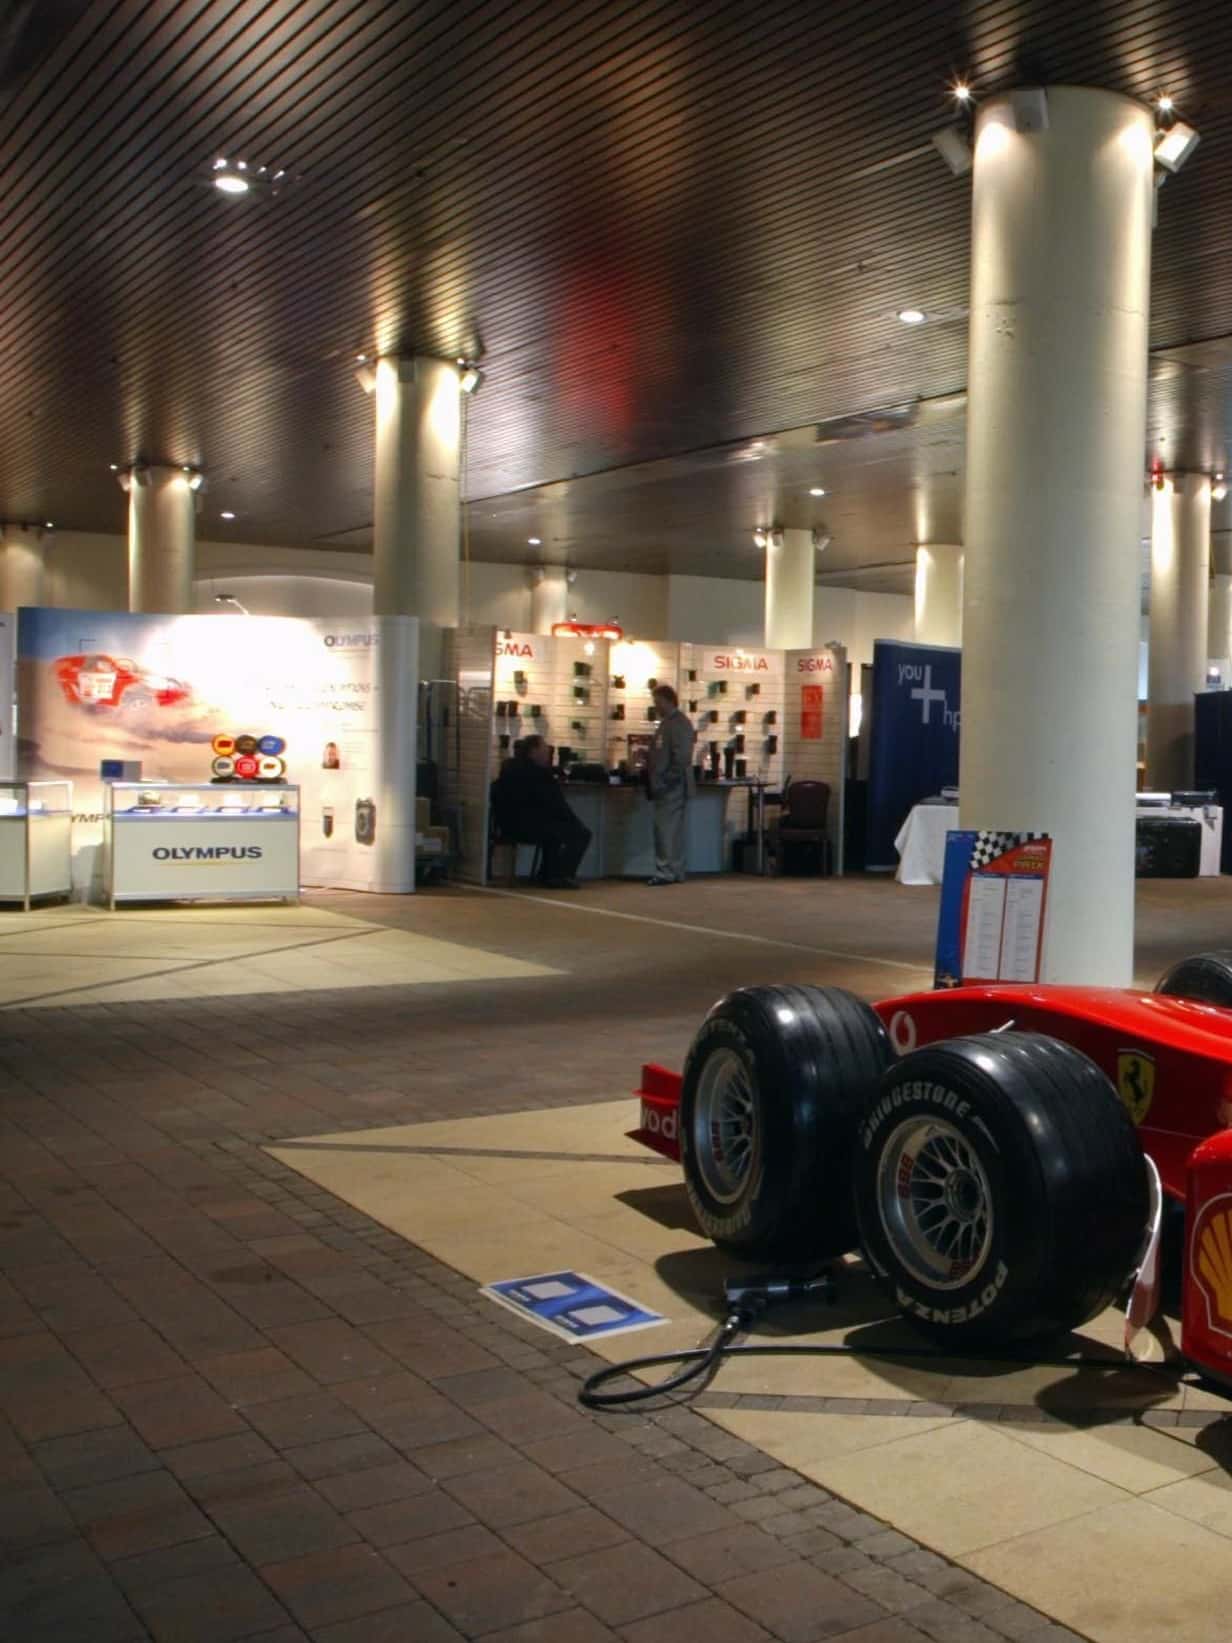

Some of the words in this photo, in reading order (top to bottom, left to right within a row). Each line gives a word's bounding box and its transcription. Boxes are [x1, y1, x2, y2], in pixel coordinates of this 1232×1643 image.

[714, 655, 768, 671] SIGMA
[798, 657, 833, 672] SIGMA
[898, 664, 922, 687] you
[152, 846, 262, 860] OLYMPUS
